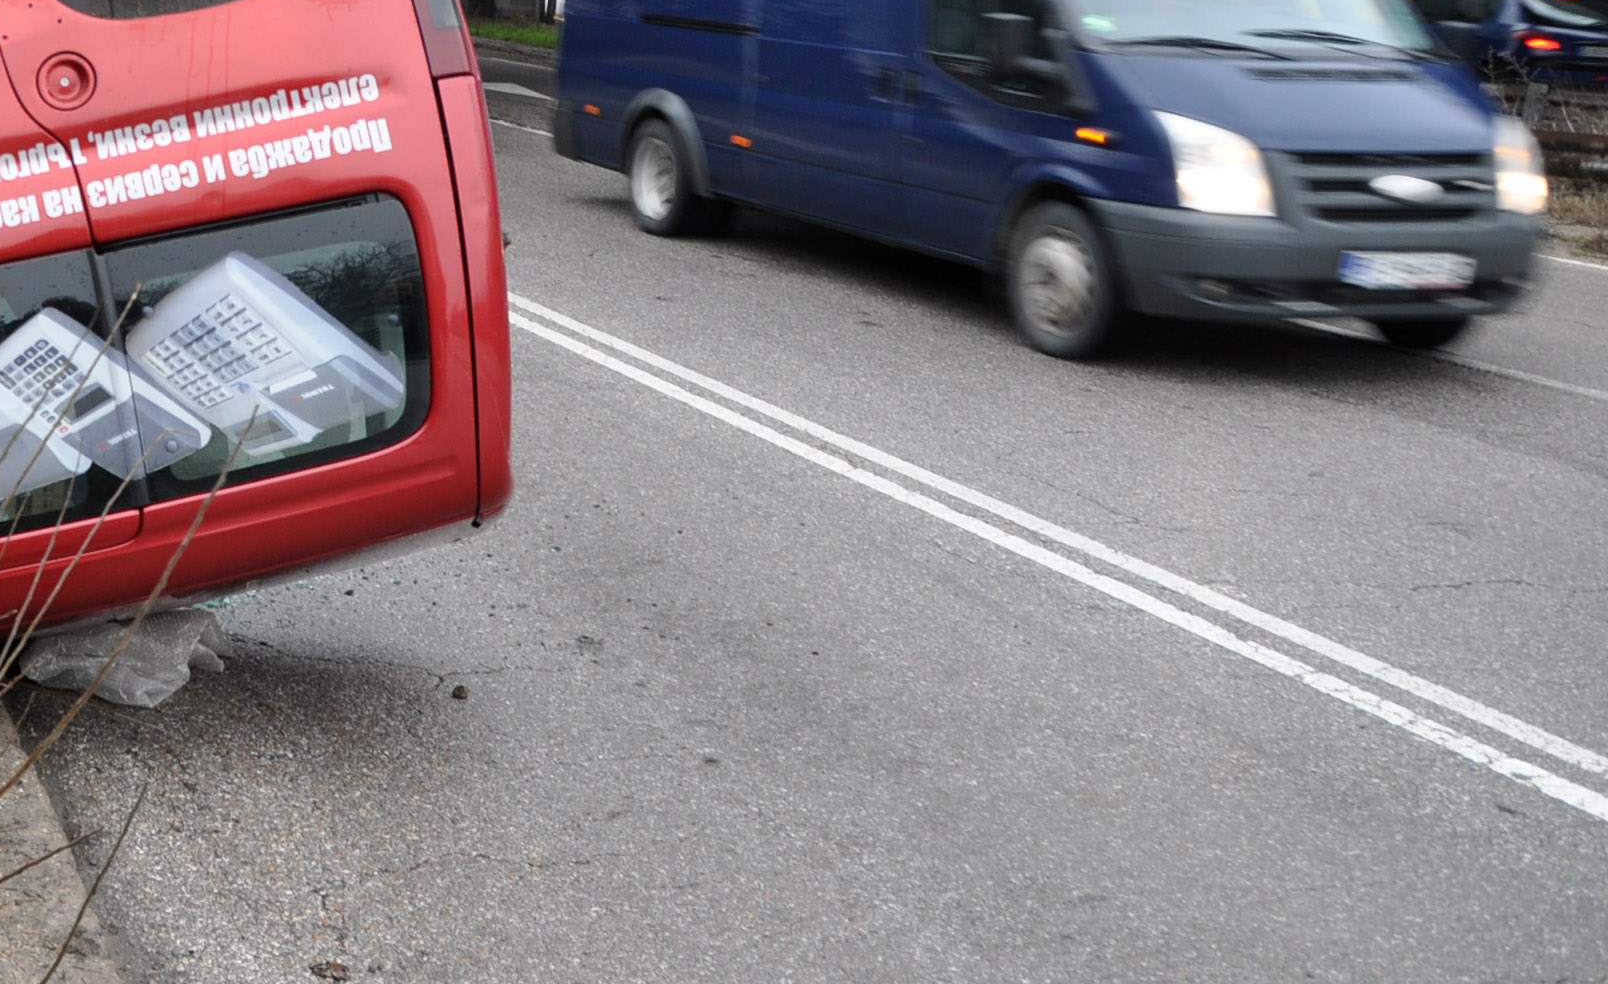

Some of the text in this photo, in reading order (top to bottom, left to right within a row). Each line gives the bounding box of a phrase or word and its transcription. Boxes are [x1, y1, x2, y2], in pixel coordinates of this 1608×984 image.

[194, 73, 380, 139] електронни
[87, 114, 193, 163] везни,
[228, 117, 393, 180] Продажба
[86, 160, 201, 209] сервиз
[200, 152, 227, 184] и
[42, 185, 84, 219] на
